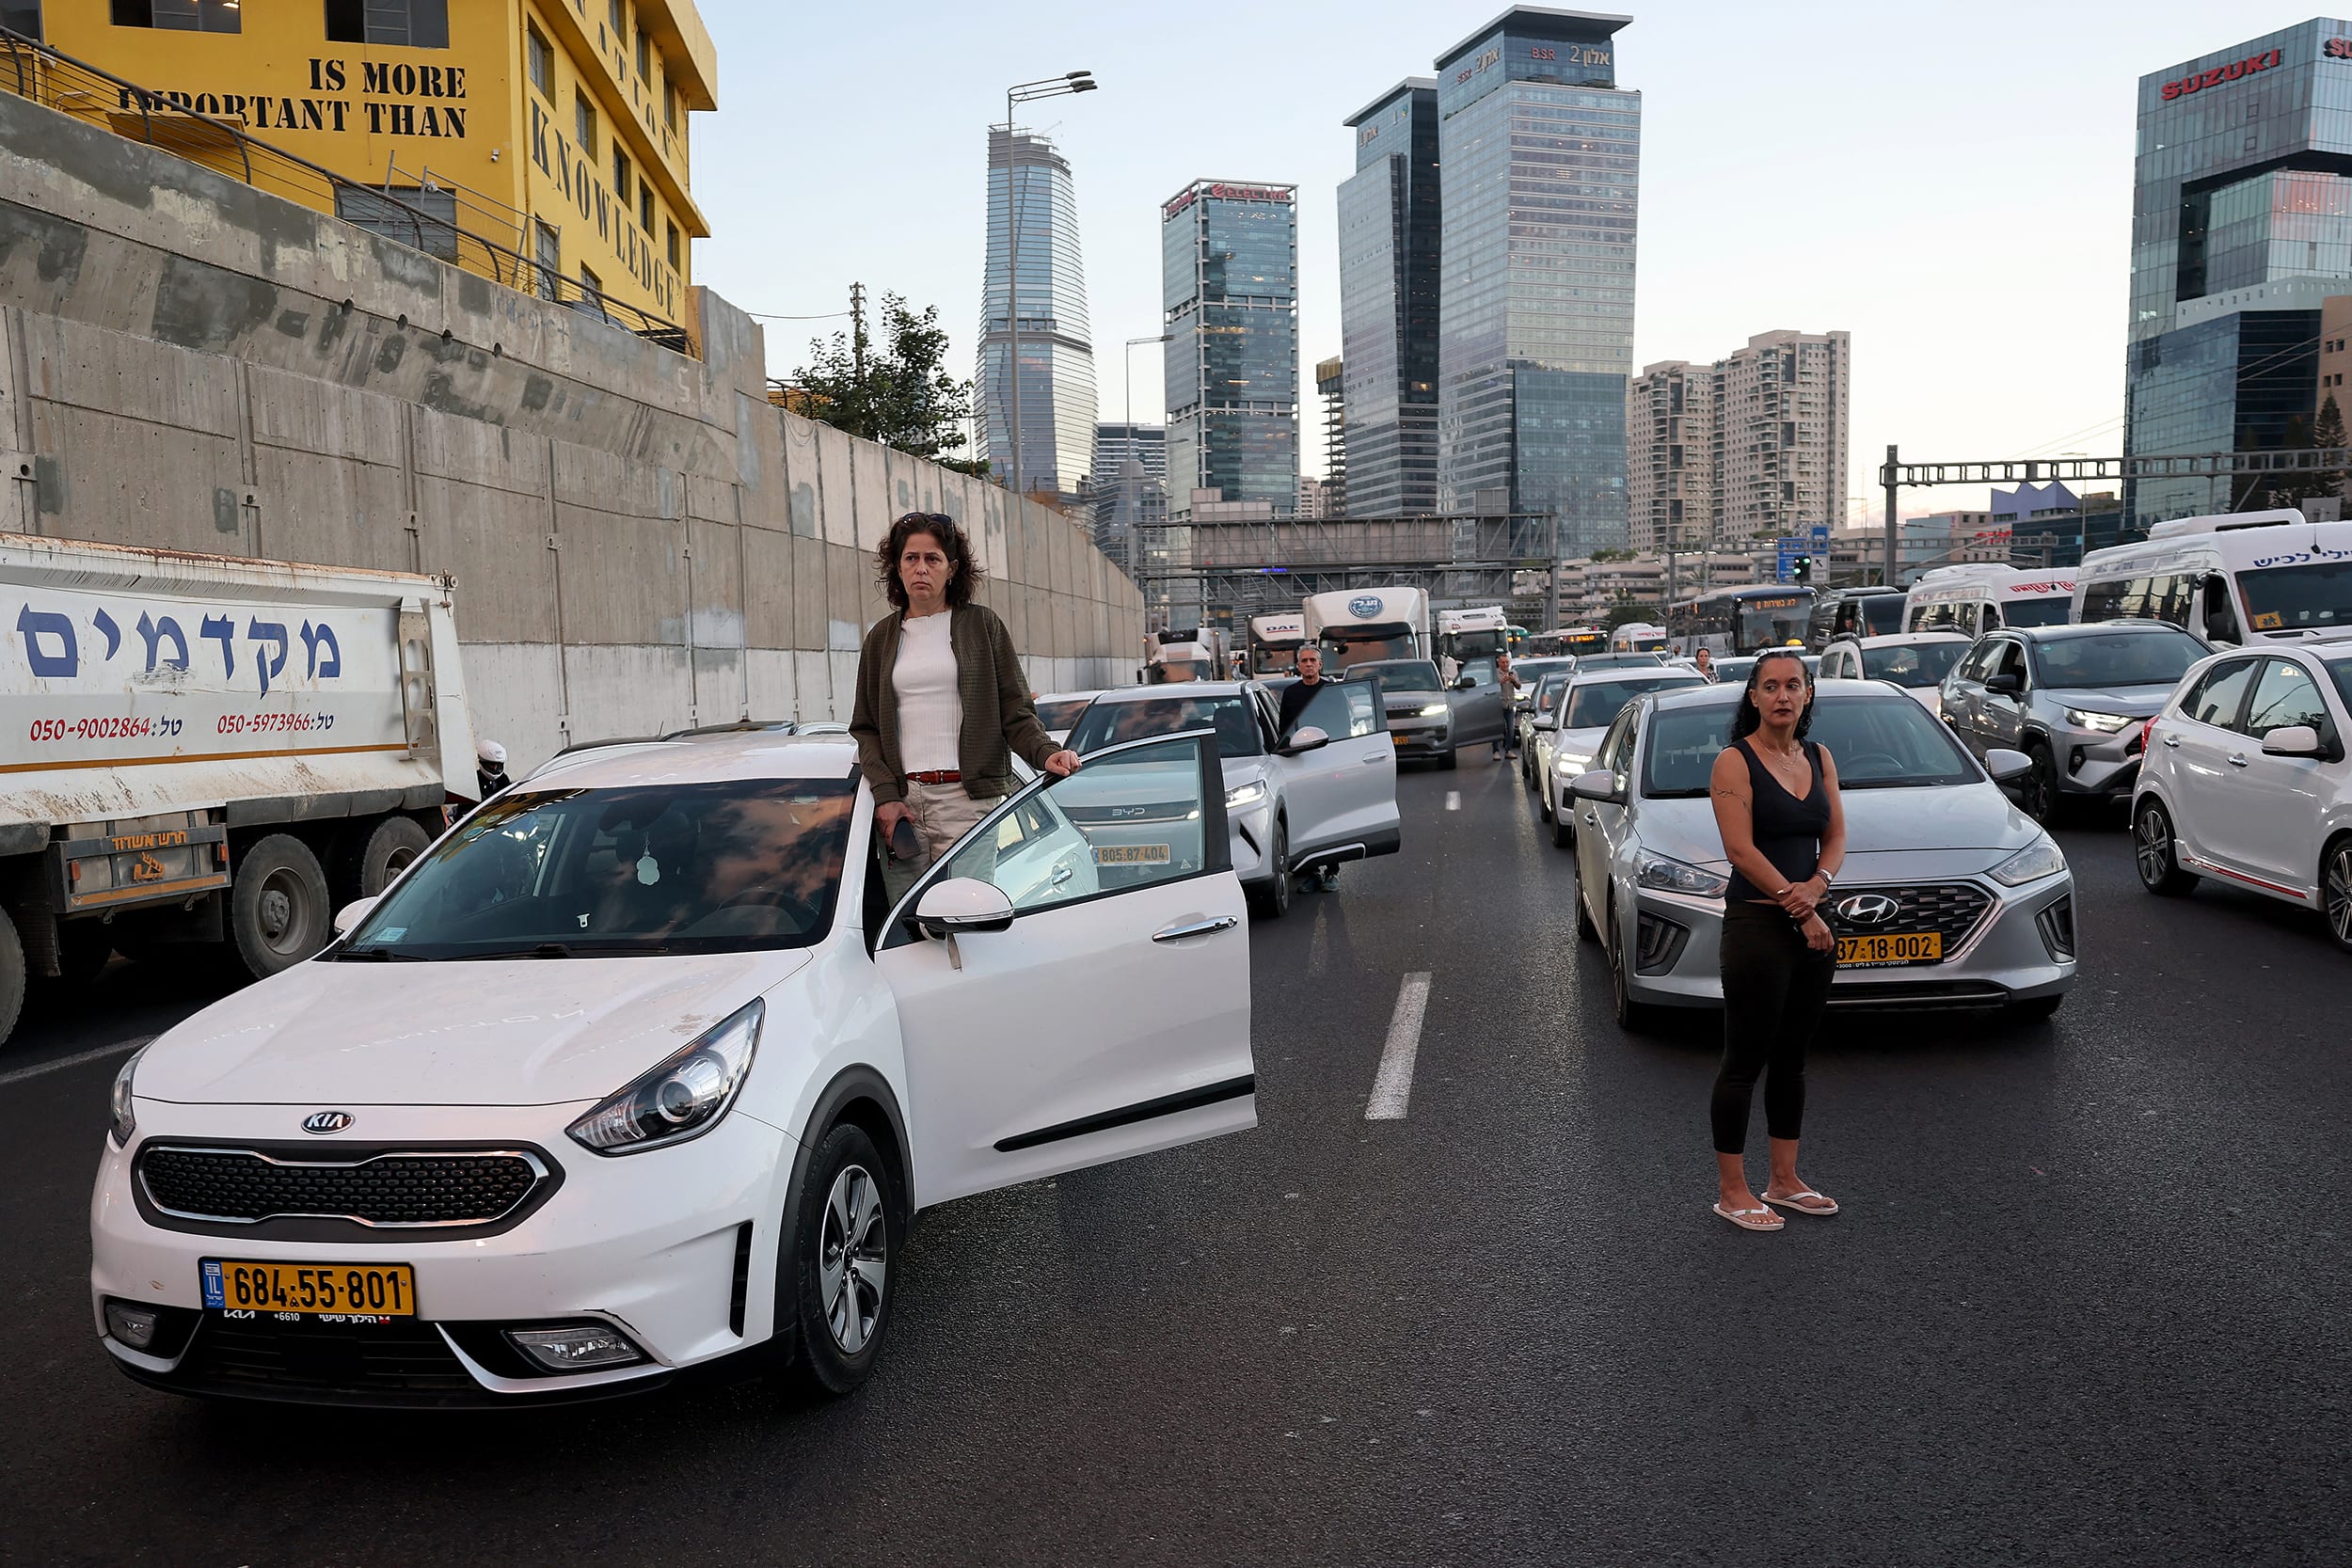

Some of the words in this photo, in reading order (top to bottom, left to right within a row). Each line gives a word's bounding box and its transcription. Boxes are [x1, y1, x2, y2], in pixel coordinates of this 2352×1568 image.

[1569, 45, 1581, 63] 2
[1582, 48, 1611, 67] אלון
[308, 58, 347, 91] IS
[362, 61, 467, 99] MORE
[2161, 49, 2280, 101] SUZUKI
[118, 87, 351, 132] IMPORTANT
[364, 103, 467, 138] THAN
[1227, 188, 1287, 200] ELECTRA
[2253, 552, 2311, 567] לכיש
[16, 602, 342, 700] מקדמים
[1111, 807, 1146, 816] BYD
[307, 1114, 344, 1128] KIA
[208, 1275, 221, 1294] IL
[224, 1309, 256, 1319] KIA
[318, 1313, 345, 1323] שישי
[347, 1314, 377, 1324] הילוך
